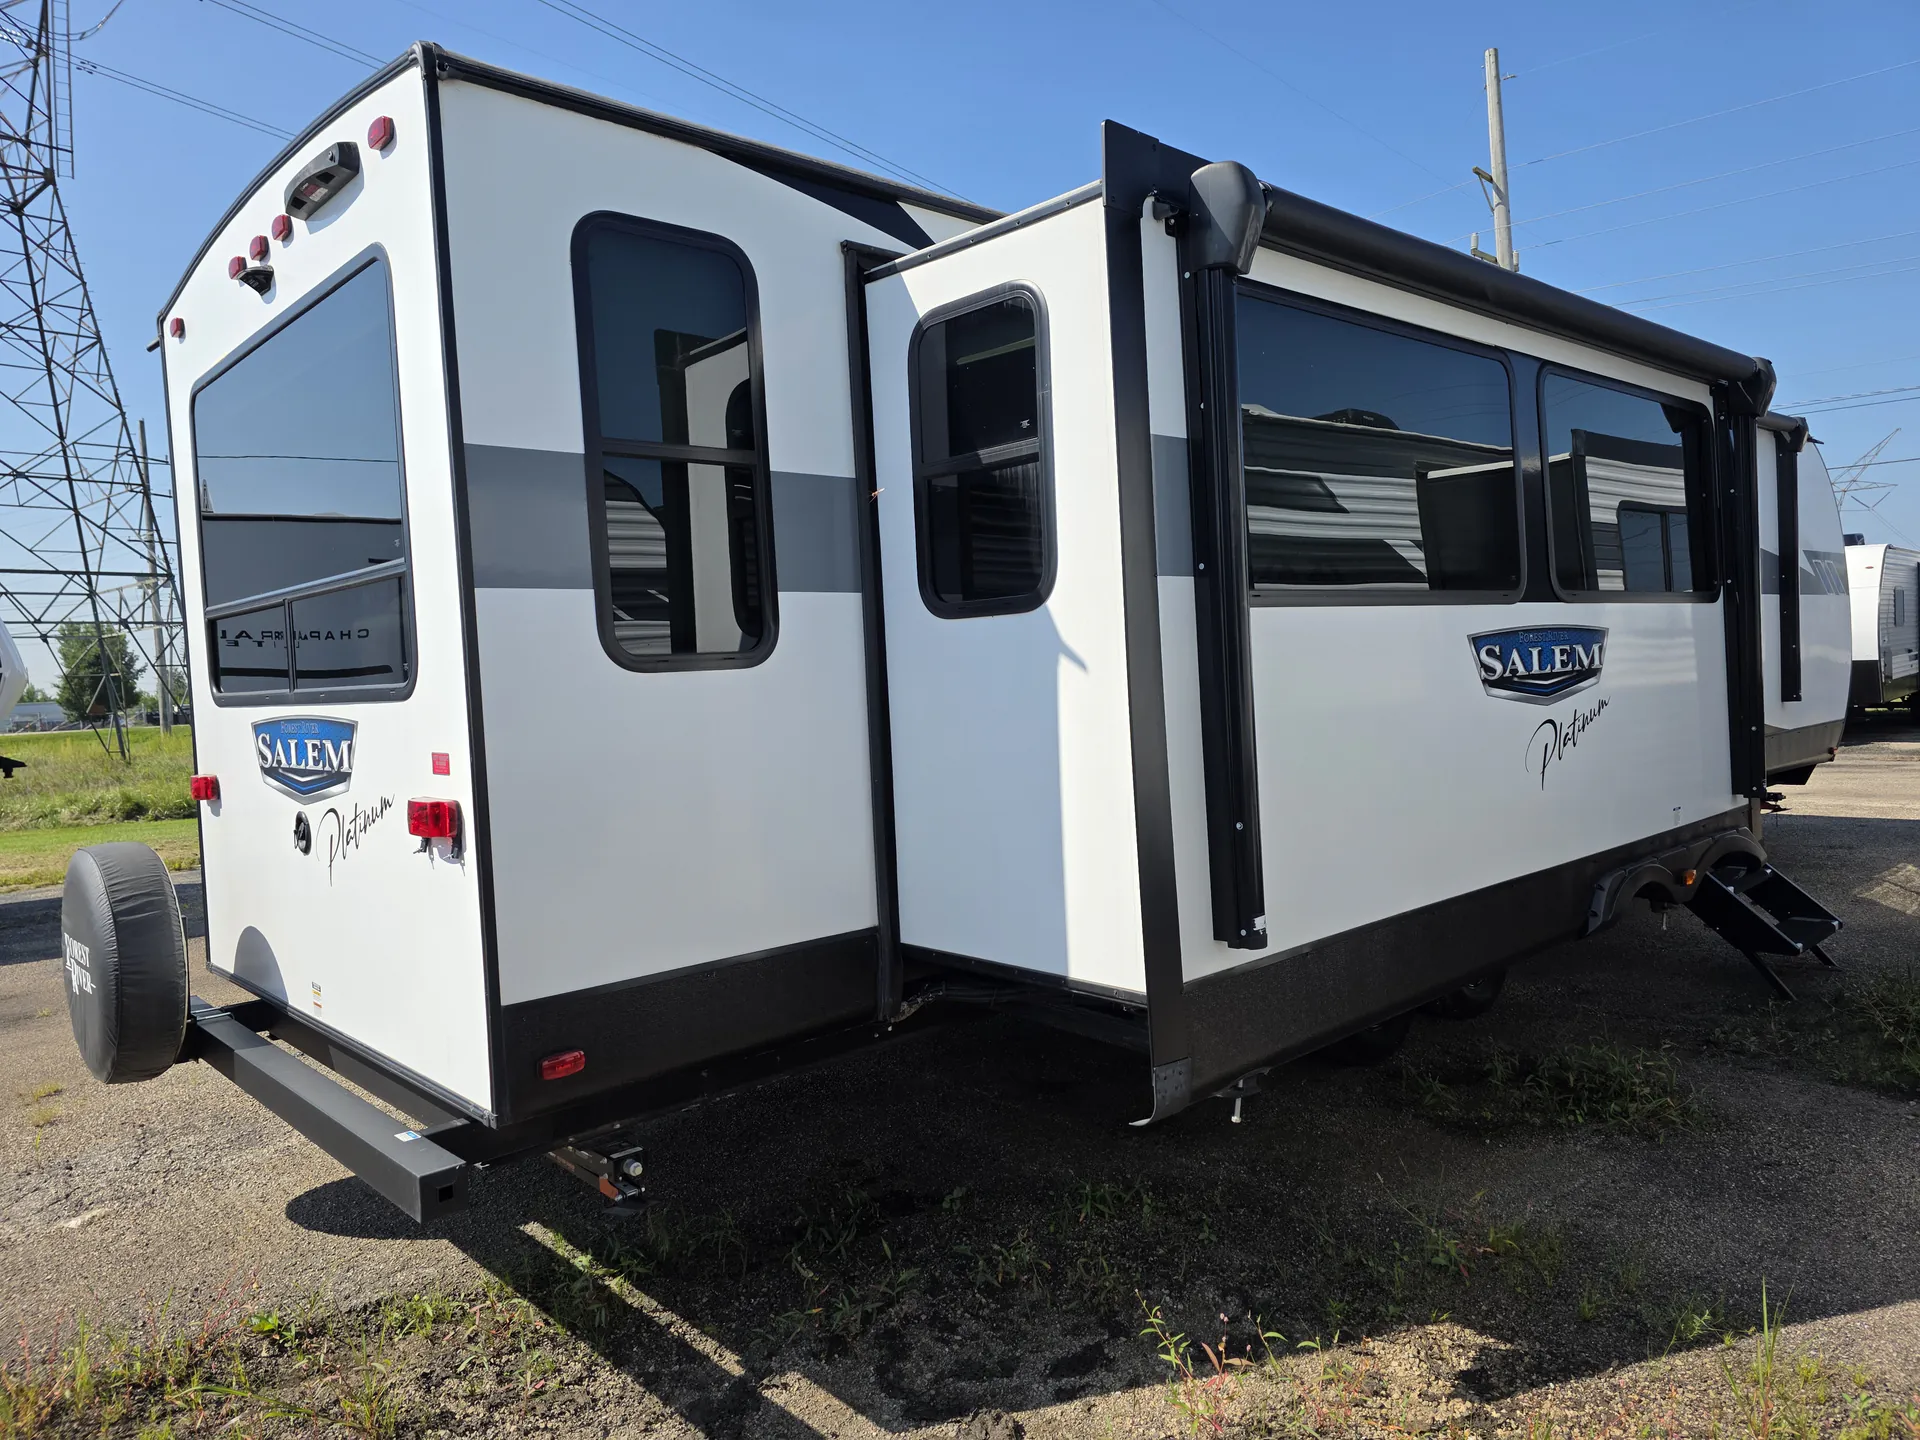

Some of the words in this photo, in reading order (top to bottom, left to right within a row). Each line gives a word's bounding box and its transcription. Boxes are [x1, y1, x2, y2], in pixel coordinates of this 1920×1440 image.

[1518, 631, 1547, 643] FOREST
[1547, 630, 1569, 641] RIVER
[1478, 642, 1603, 681] SALEM
[280, 721, 301, 734] FOREST
[301, 721, 319, 734] RIVER
[1525, 696, 1611, 791] Platinum
[257, 732, 353, 773] SALEM
[316, 793, 395, 887] Platinum
[64, 932, 90, 967] FOREST
[69, 957, 93, 995] RIVER
